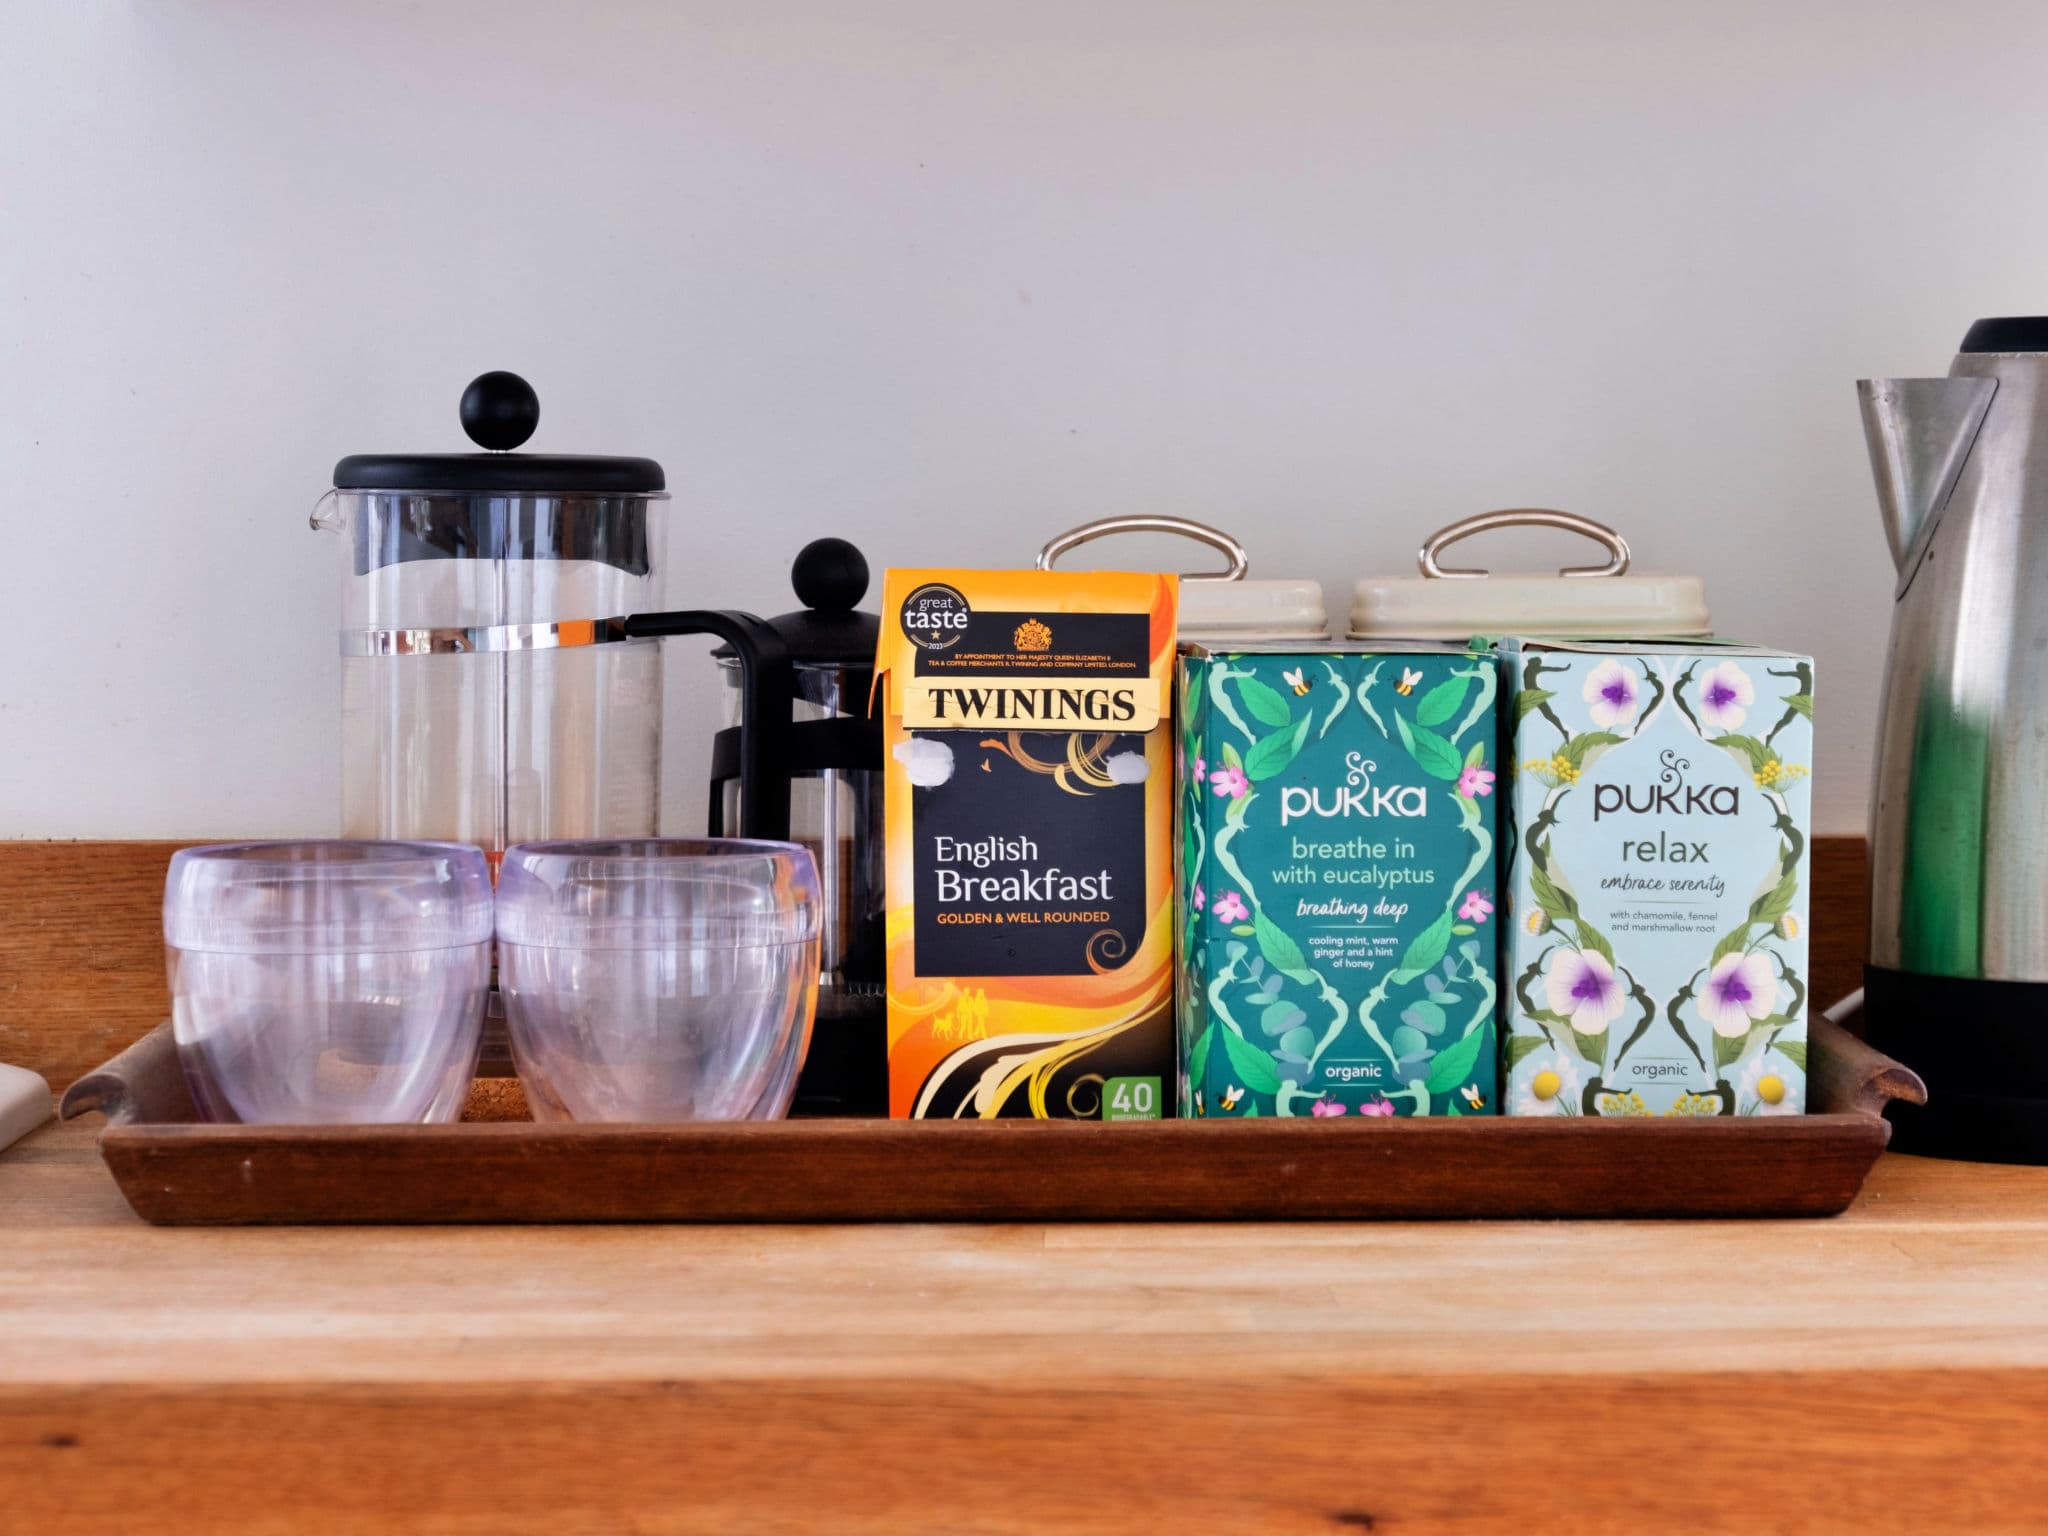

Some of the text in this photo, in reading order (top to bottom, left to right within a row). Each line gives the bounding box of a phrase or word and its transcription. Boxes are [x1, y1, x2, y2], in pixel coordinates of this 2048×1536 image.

[919, 597, 953, 612] great
[905, 609, 968, 629] taste
[928, 642, 944, 650] 2023
[928, 689, 1136, 721] TWININGS
[934, 836, 1038, 868] English
[1292, 836, 1415, 859] breathe in
[1623, 831, 1710, 863] relax
[934, 868, 1114, 902] Breakfast
[1272, 864, 1435, 890] with eucalyptus
[1600, 873, 1726, 898] embrace serenity
[937, 911, 1110, 924] GOLDEN & WELL ROUNDED
[1296, 896, 1409, 924] breathing deep
[1610, 910, 1718, 921] with chamomile, fennel
[1611, 922, 1716, 933] and marshmallow root
[1308, 936, 1344, 947] cooling
[1346, 936, 1370, 946] mint,
[1314, 949, 1344, 959] ginger
[1347, 948, 1365, 957] and
[1375, 948, 1393, 957] hint
[1333, 959, 1375, 970] of honey
[1325, 1063, 1382, 1082] organic
[1632, 1062, 1689, 1080] organic
[1112, 1083, 1152, 1112] 40
